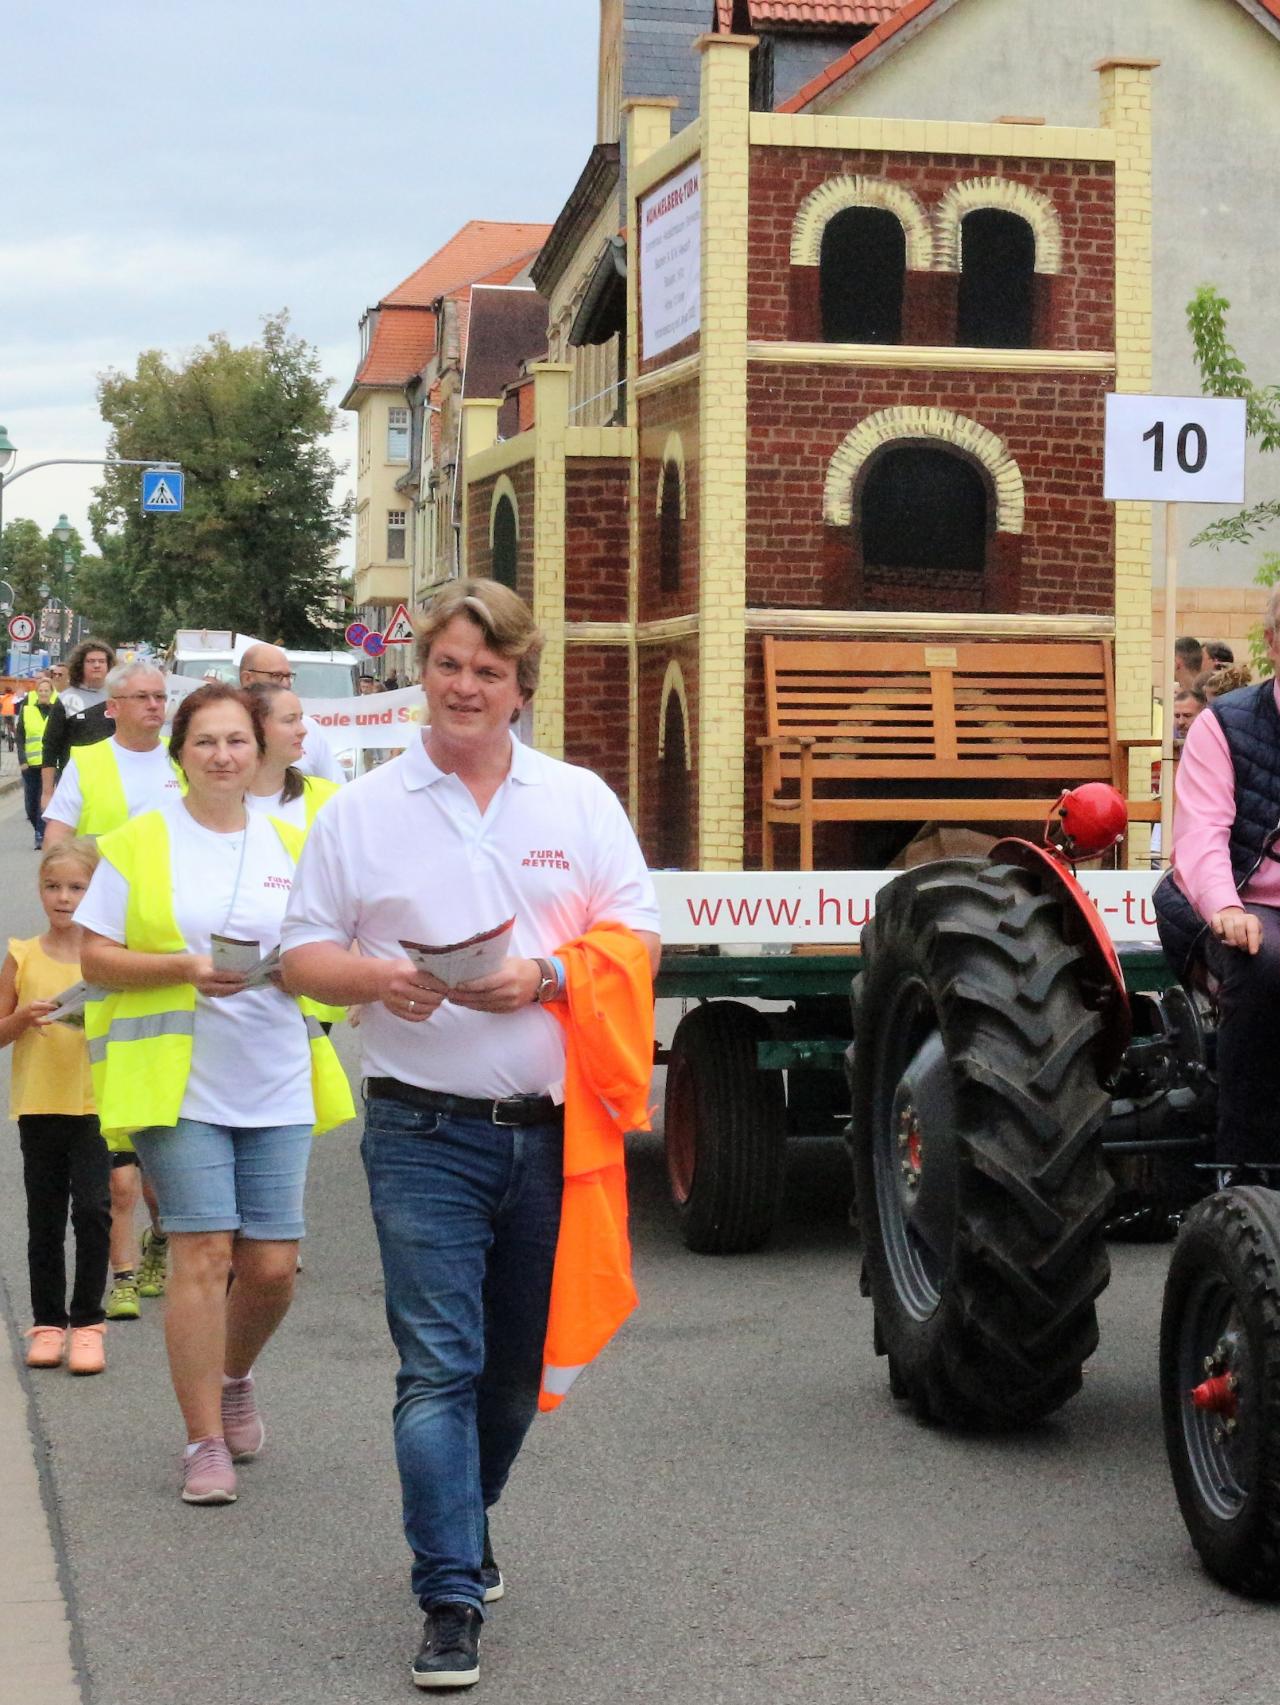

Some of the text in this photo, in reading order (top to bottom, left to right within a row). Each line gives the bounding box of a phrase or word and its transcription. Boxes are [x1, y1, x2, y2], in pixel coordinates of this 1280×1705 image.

[1143, 421, 1208, 474] 10
[355, 708, 393, 726] und
[529, 850, 565, 859] TURM
[522, 858, 570, 871] RETTER
[686, 888, 870, 926] www.hu
